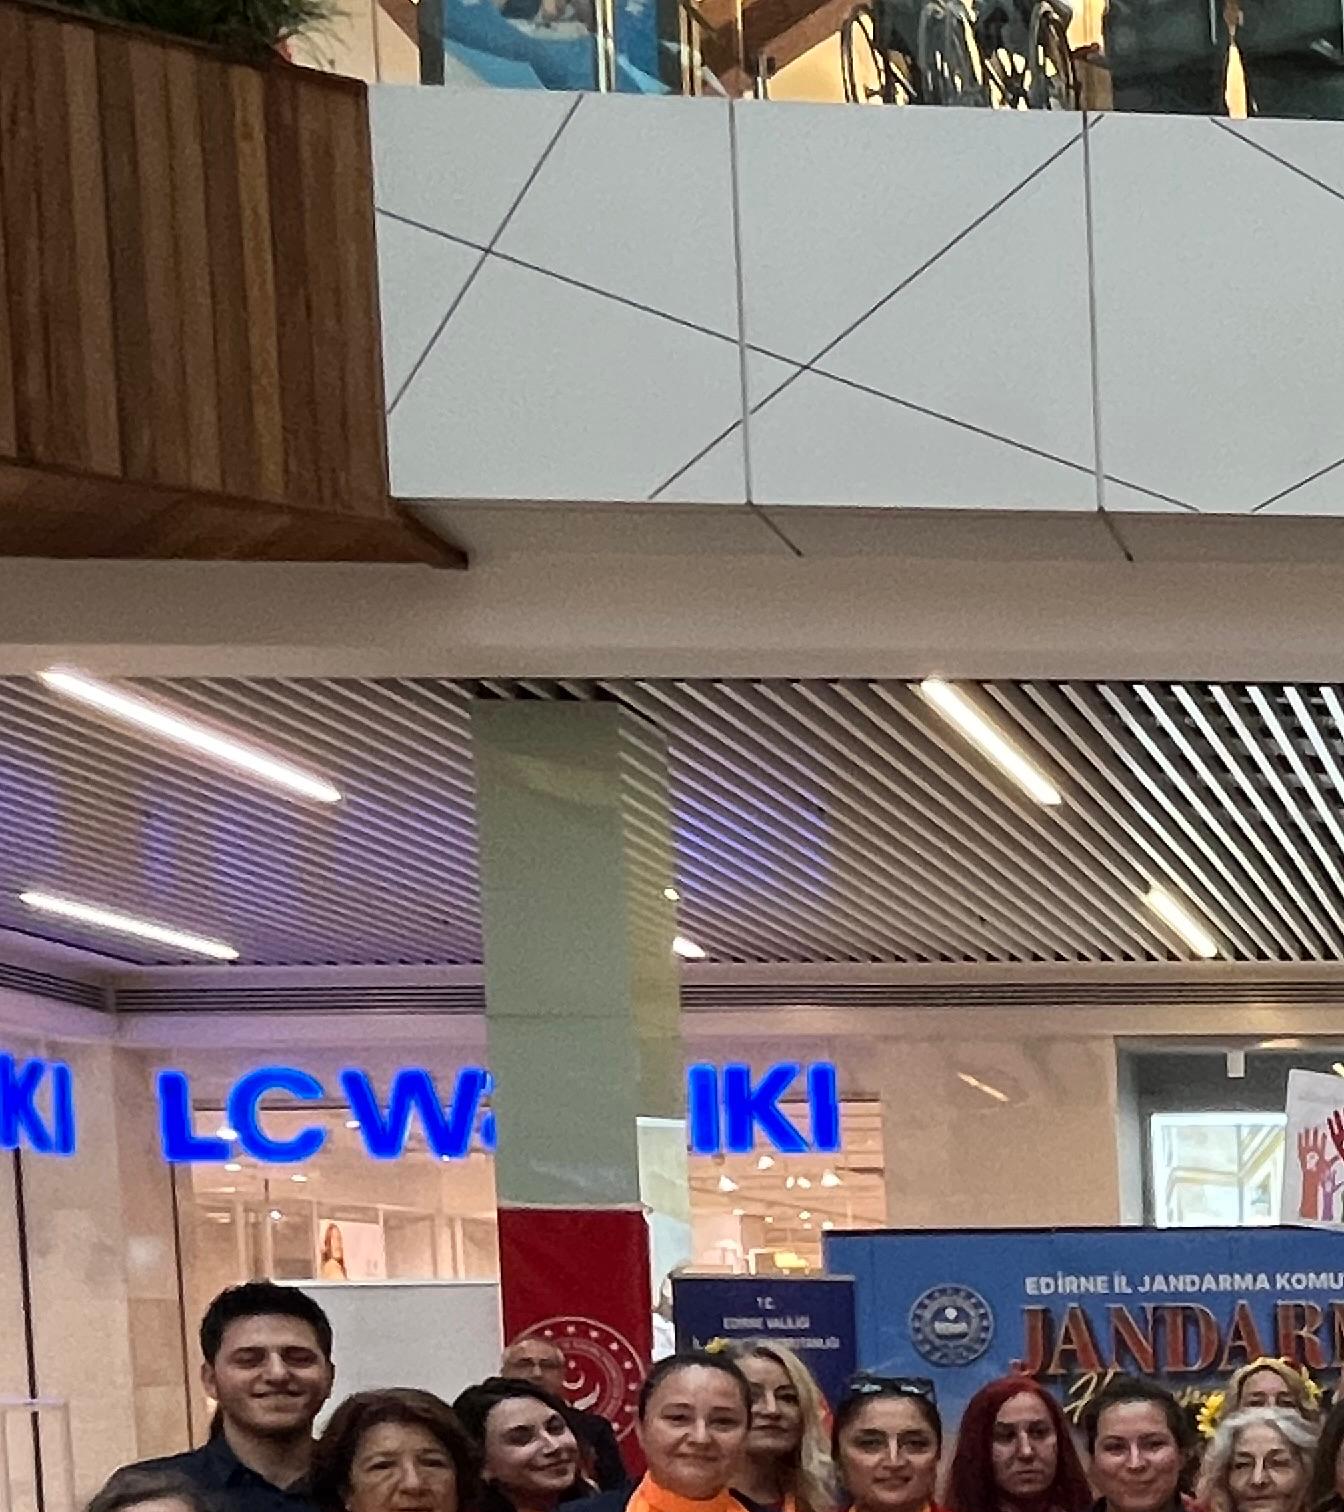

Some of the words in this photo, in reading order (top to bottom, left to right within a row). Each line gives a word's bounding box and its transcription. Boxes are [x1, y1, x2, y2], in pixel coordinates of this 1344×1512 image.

[157, 1066, 325, 1163] LC
[1025, 1271, 1109, 1296] EDİRNE
[1137, 1272, 1270, 1293] JANDARMA
